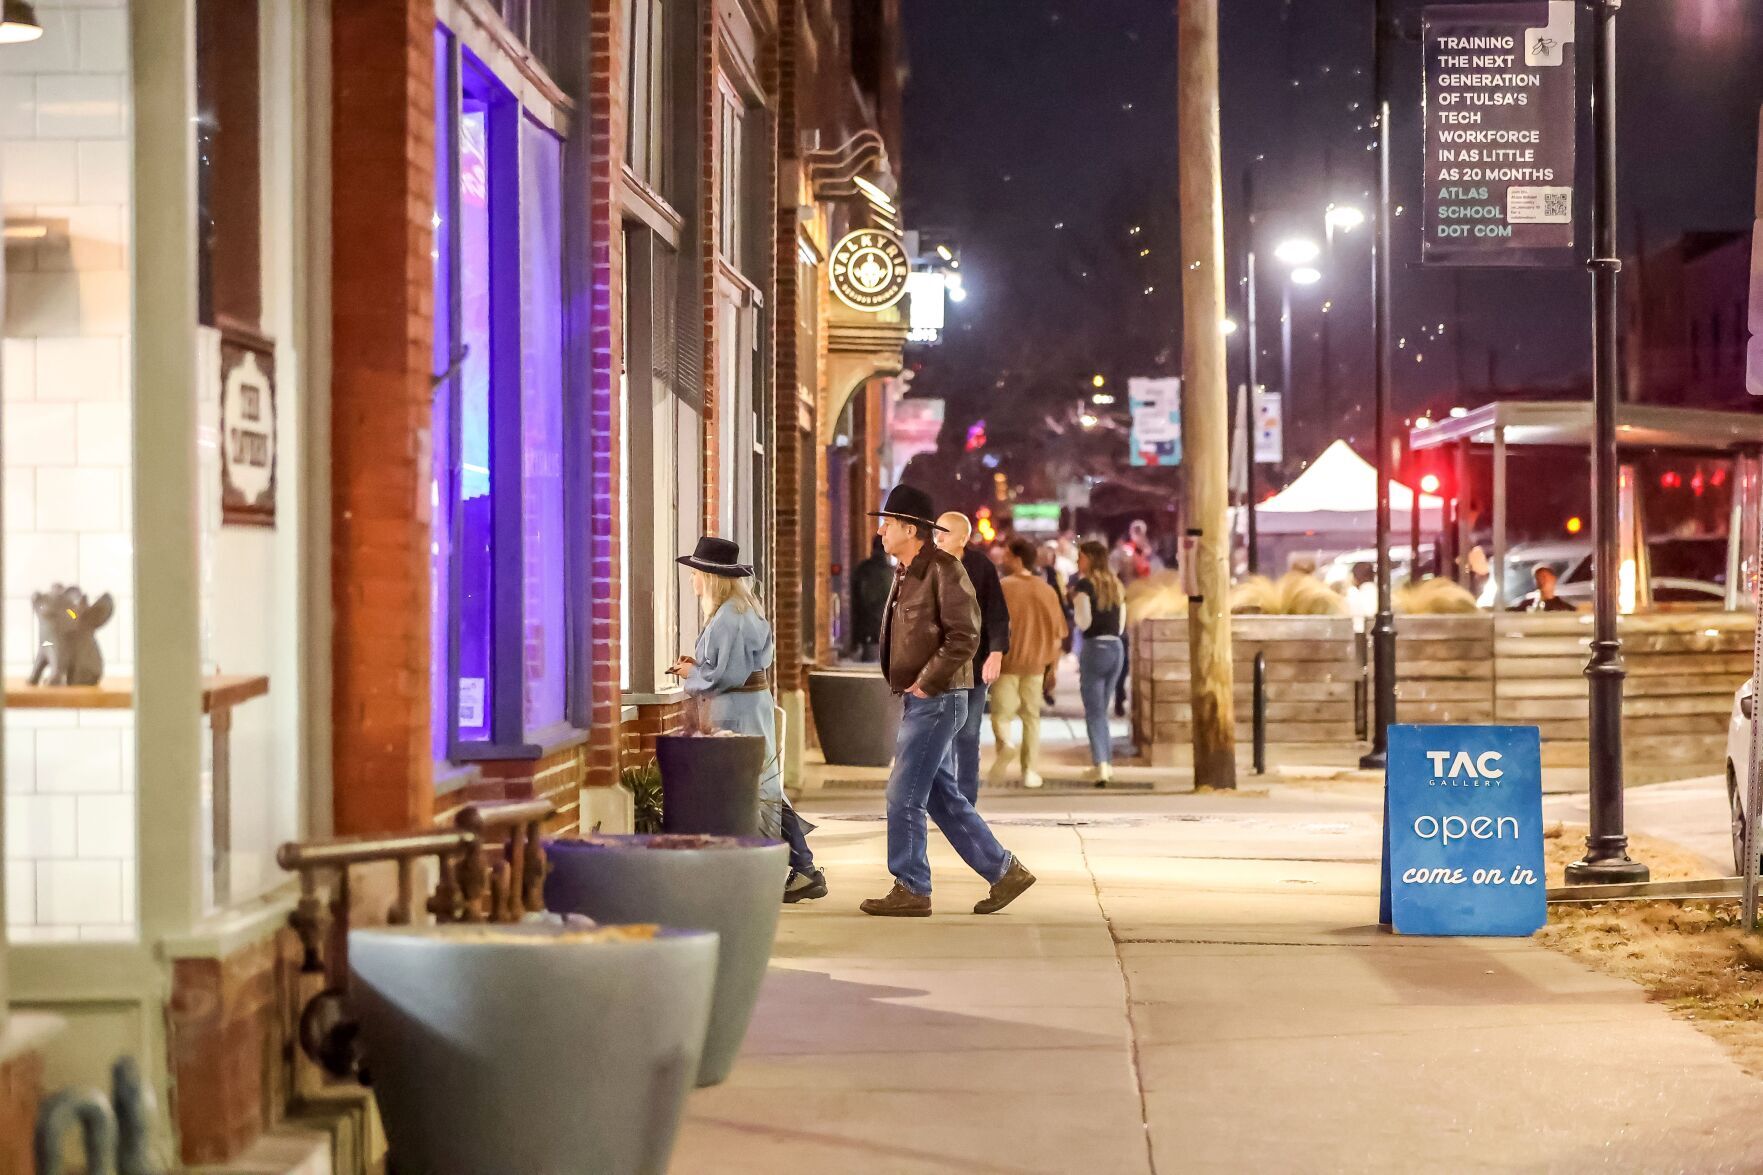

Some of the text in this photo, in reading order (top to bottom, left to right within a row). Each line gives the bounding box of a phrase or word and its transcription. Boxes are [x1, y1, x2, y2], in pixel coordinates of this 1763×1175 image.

[1437, 36, 1514, 49] TRAINING
[1437, 55, 1515, 68] THE NEXT
[1438, 74, 1540, 87] GENERATION
[1438, 92, 1528, 106] OF TULSA'S
[1438, 111, 1481, 124] TECH
[1438, 130, 1540, 143] WORKFORCE
[1438, 149, 1535, 162] IN AS LITTLE
[1438, 168, 1554, 181] AS 20 MONTHS
[1438, 187, 1489, 200] ATLAS
[1438, 205, 1505, 219] SCHOOL
[1437, 224, 1513, 238] DOT COM
[834, 234, 907, 276] VALKYRIE
[1426, 750, 1504, 779] TAC
[1429, 779, 1502, 787] GALLERY
[1413, 815, 1519, 846] open
[1402, 865, 1538, 885] come on in
